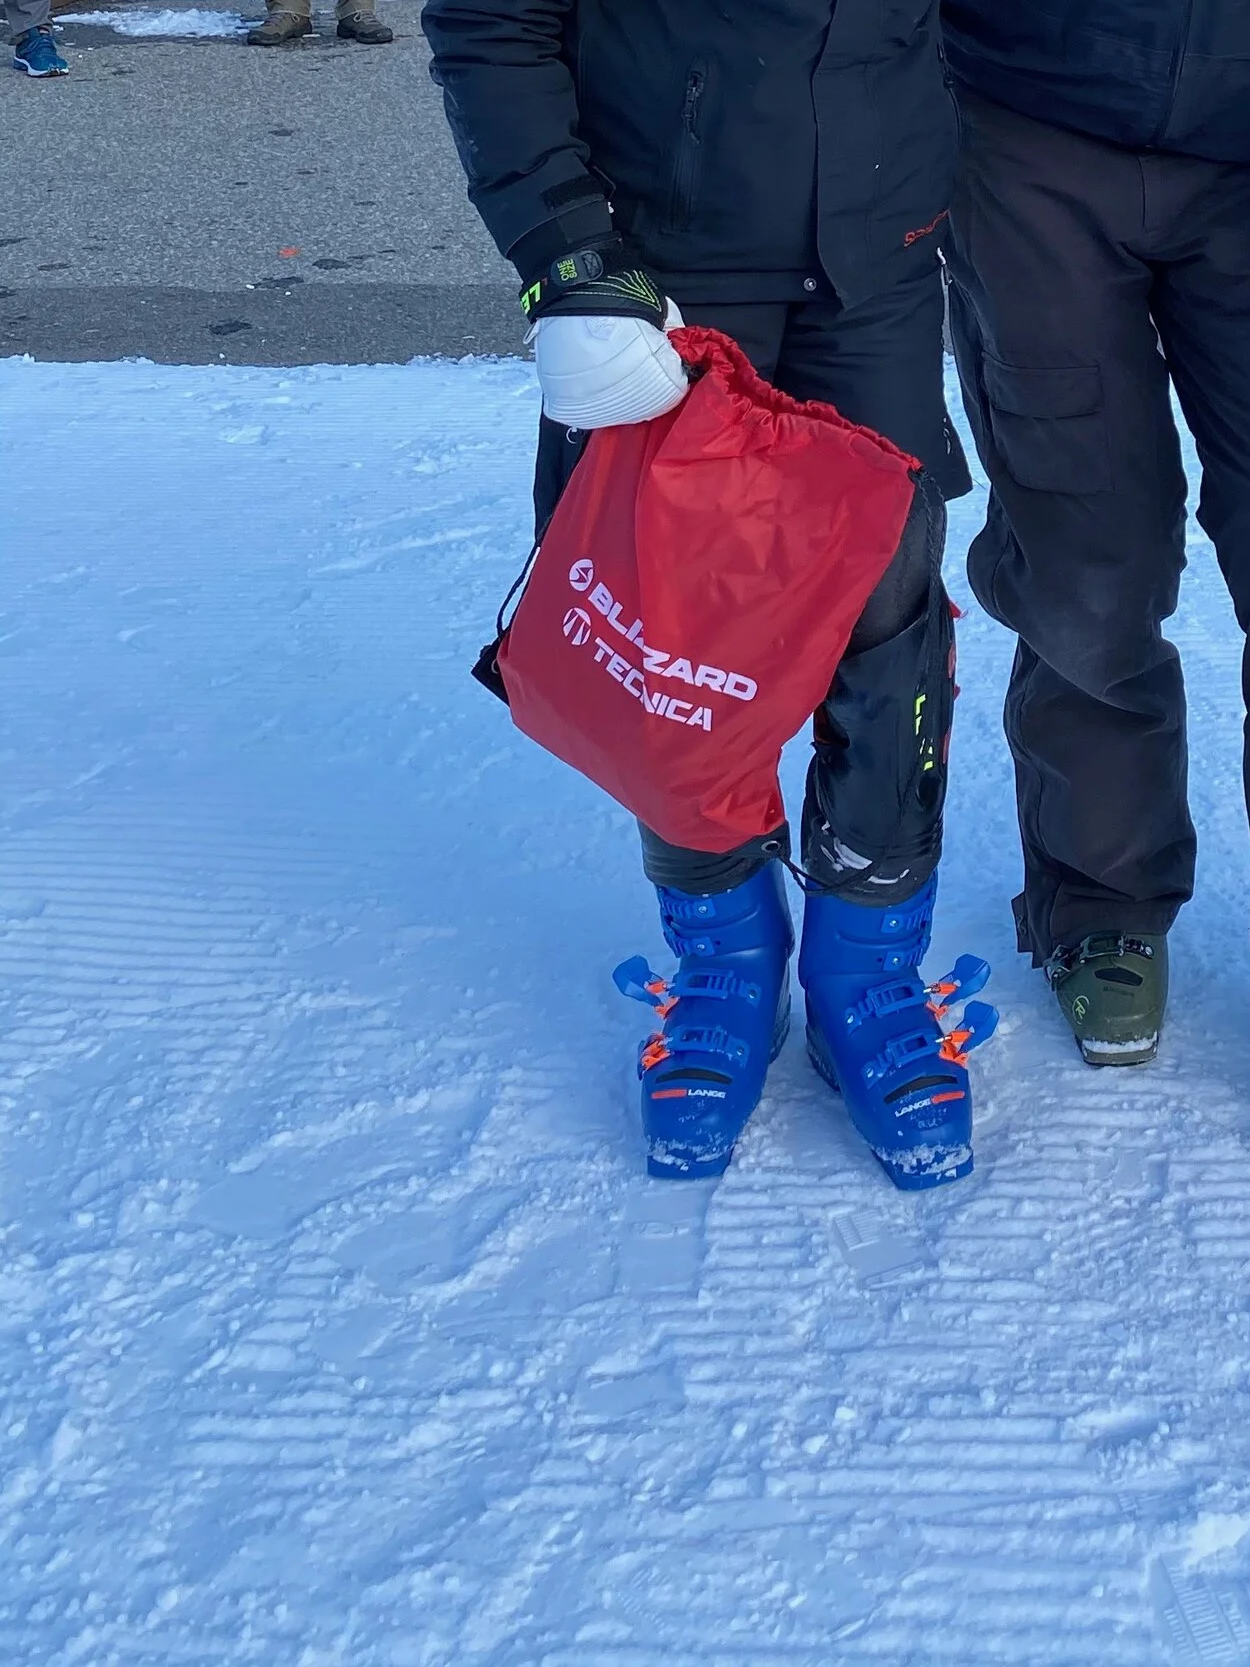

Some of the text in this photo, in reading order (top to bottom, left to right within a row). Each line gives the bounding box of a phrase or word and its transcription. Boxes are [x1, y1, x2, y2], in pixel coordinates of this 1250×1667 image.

[587, 582, 758, 701] BLIZARD
[593, 636, 712, 732] TECNICA
[688, 1088, 727, 1099] LANGE
[894, 1097, 932, 1117] LANGE
